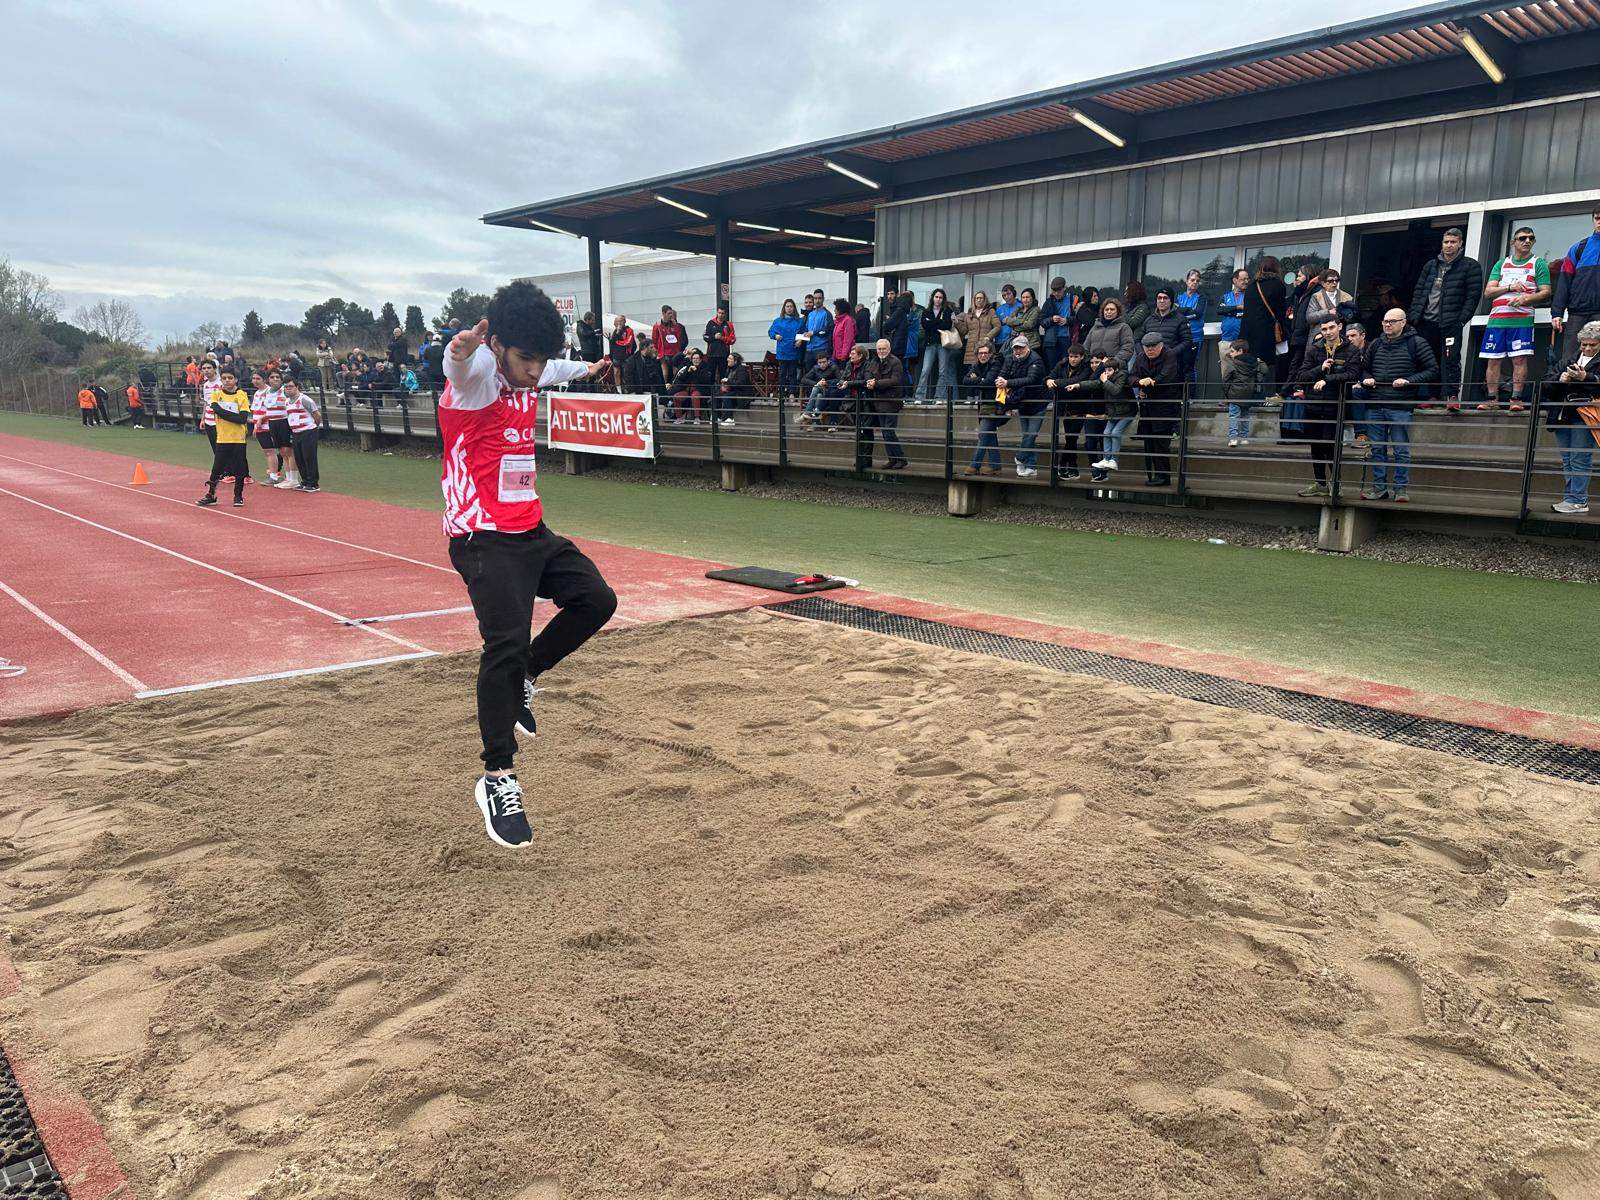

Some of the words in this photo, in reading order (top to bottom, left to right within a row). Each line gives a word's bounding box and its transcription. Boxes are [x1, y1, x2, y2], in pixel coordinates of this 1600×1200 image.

[555, 299, 574, 309] CLUB
[551, 409, 635, 436] ATLETISME
[519, 474, 530, 486] 42
